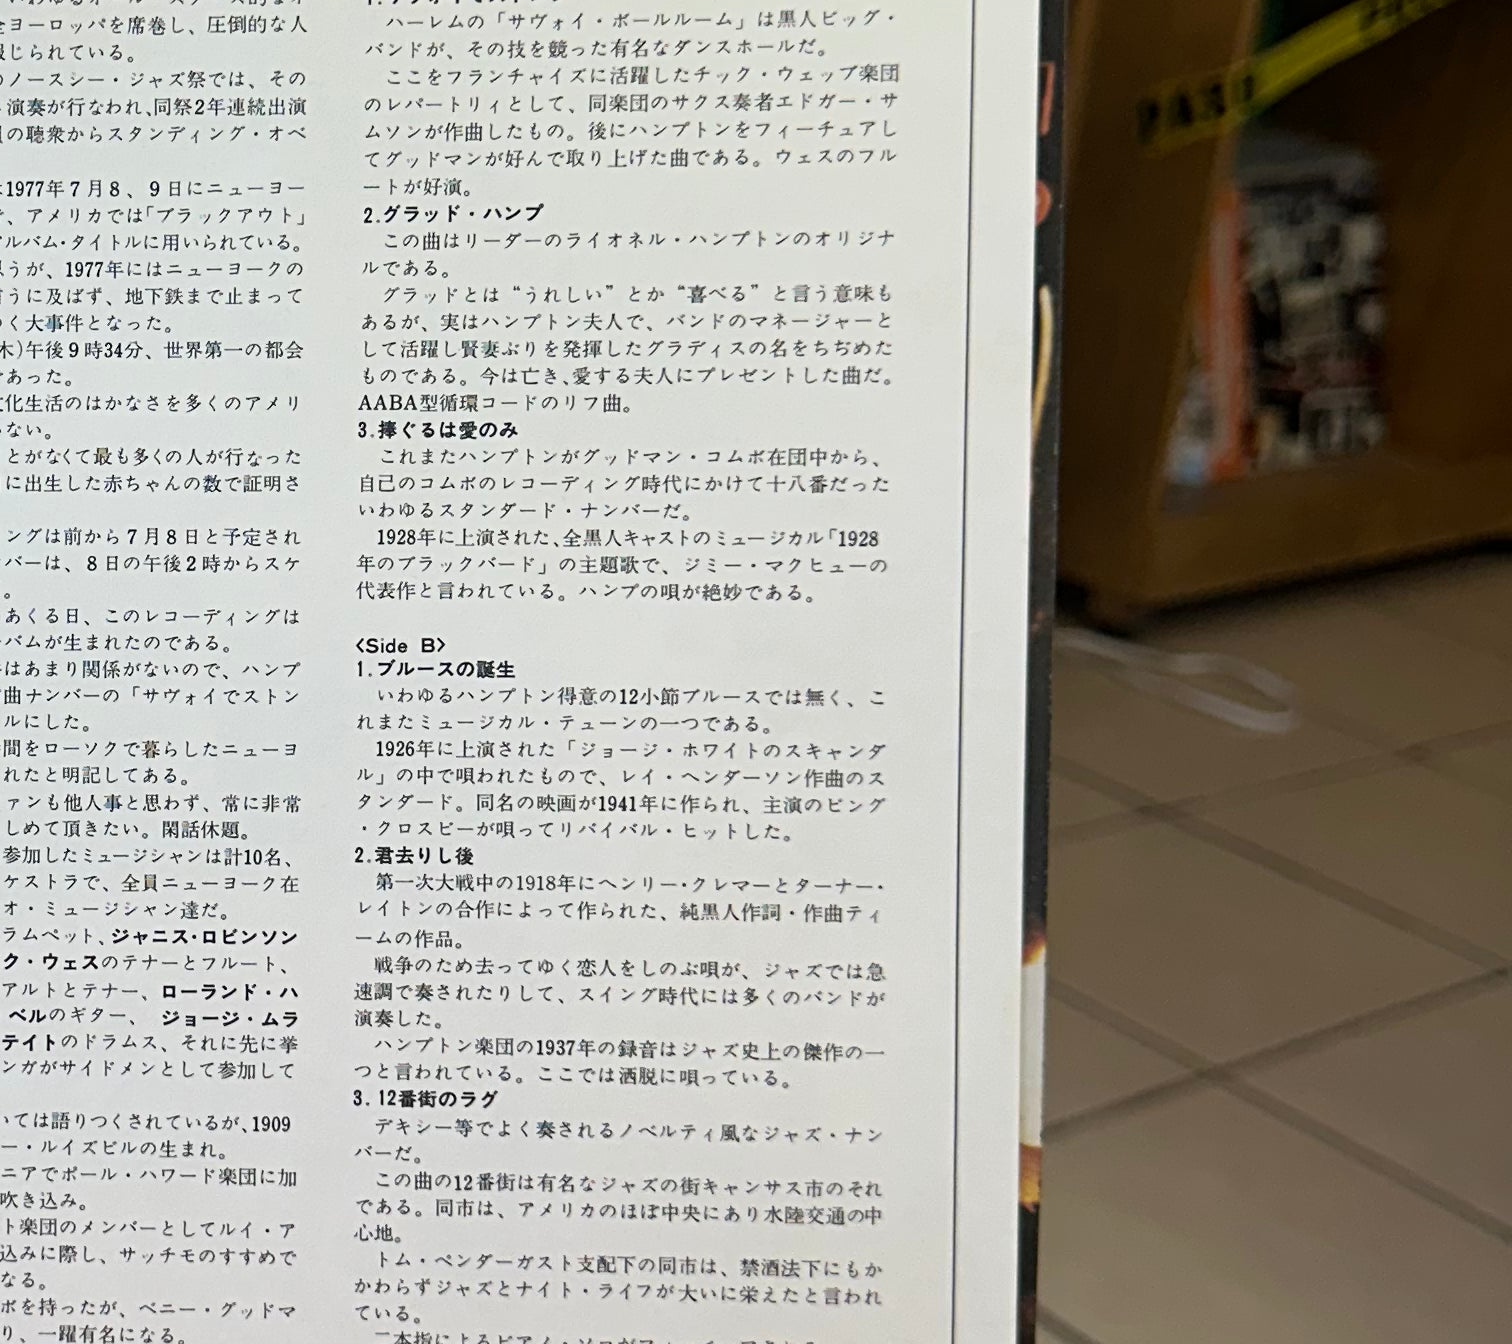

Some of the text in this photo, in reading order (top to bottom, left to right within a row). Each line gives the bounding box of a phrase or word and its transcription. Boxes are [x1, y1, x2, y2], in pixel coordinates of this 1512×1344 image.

[363, 178, 470, 197] ートが好演。
[362, 260, 448, 278] ルである。
[355, 929, 462, 949] ームの作品。
[354, 1009, 441, 1029] 演奏した。
[354, 1146, 421, 1164] バーだ。
[354, 1224, 401, 1244] 心地。
[355, 1305, 420, 1324] ている。
